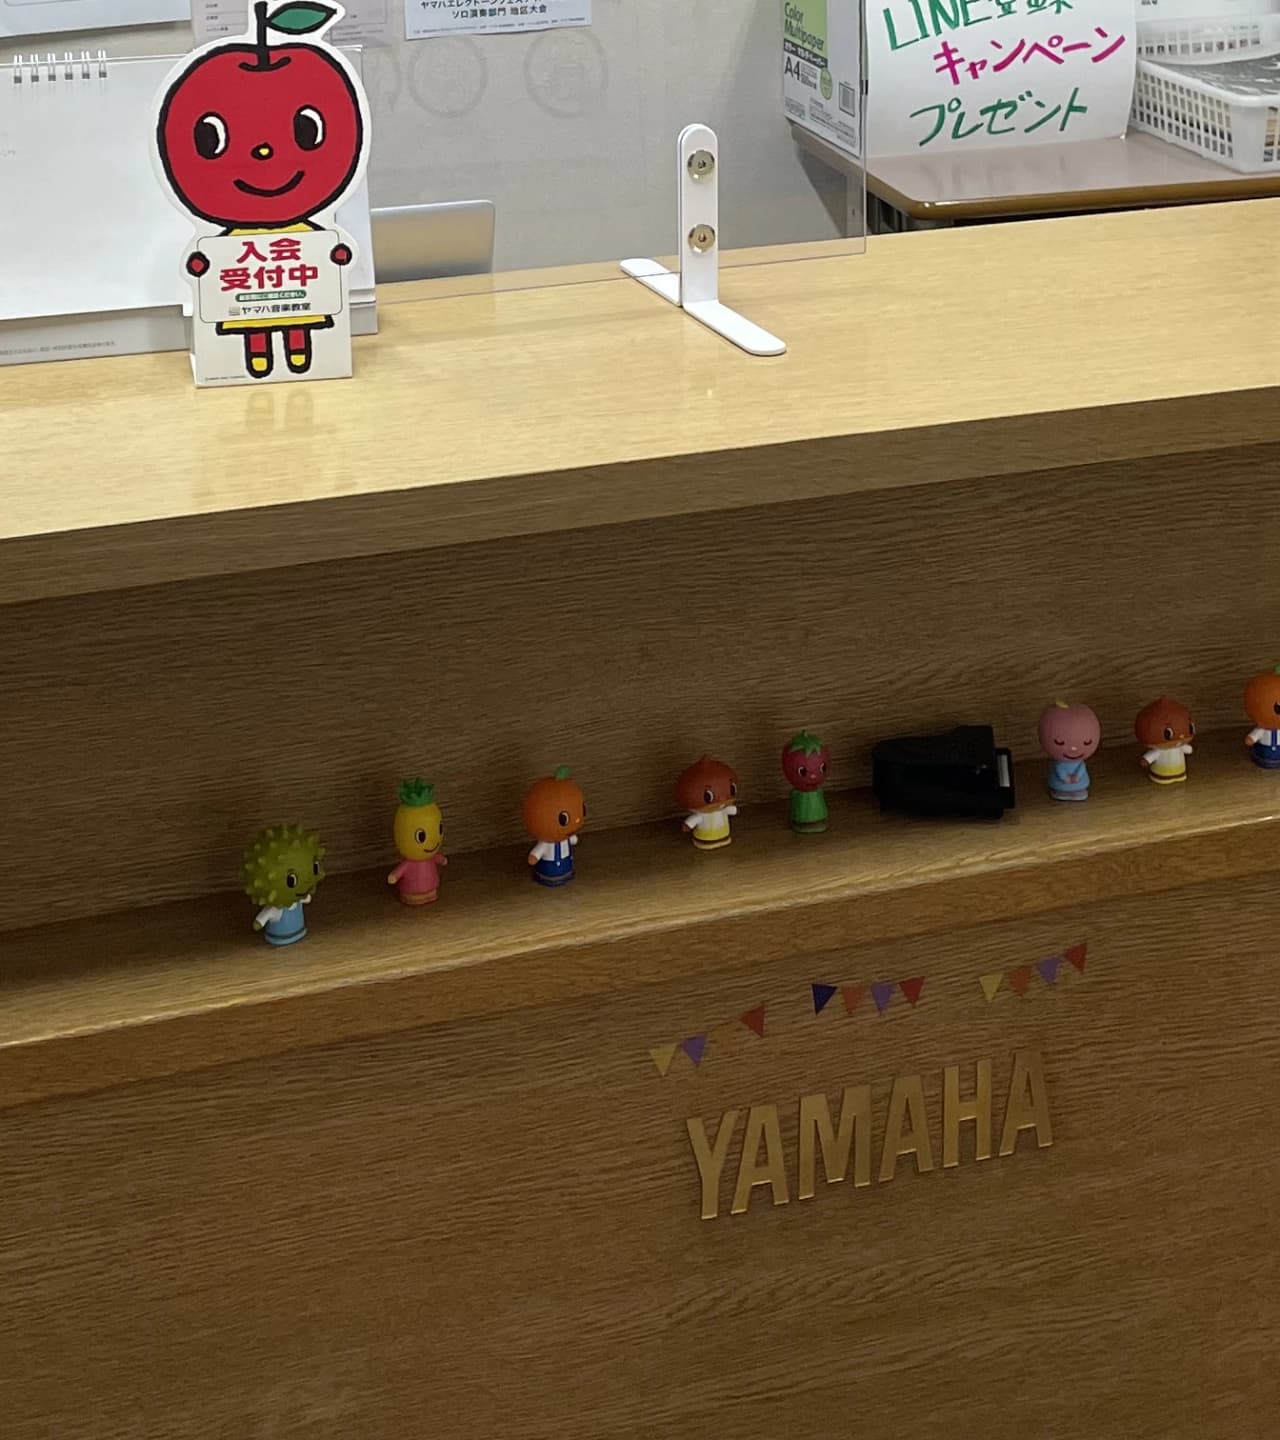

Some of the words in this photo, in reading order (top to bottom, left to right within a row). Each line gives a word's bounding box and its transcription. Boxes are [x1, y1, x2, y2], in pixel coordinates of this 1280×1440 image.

[784, 2, 804, 20] Color
[784, 18, 824, 51] Multipaper
[784, 56, 801, 81] A4
[934, 26, 1126, 85] キャンペーン
[910, 86, 1088, 147] プレゼント
[236, 238, 301, 264] 入会
[220, 264, 318, 292] 受付中
[241, 303, 311, 314] ヤマハ音楽教室
[686, 1050, 1055, 1221] YAMAHA
